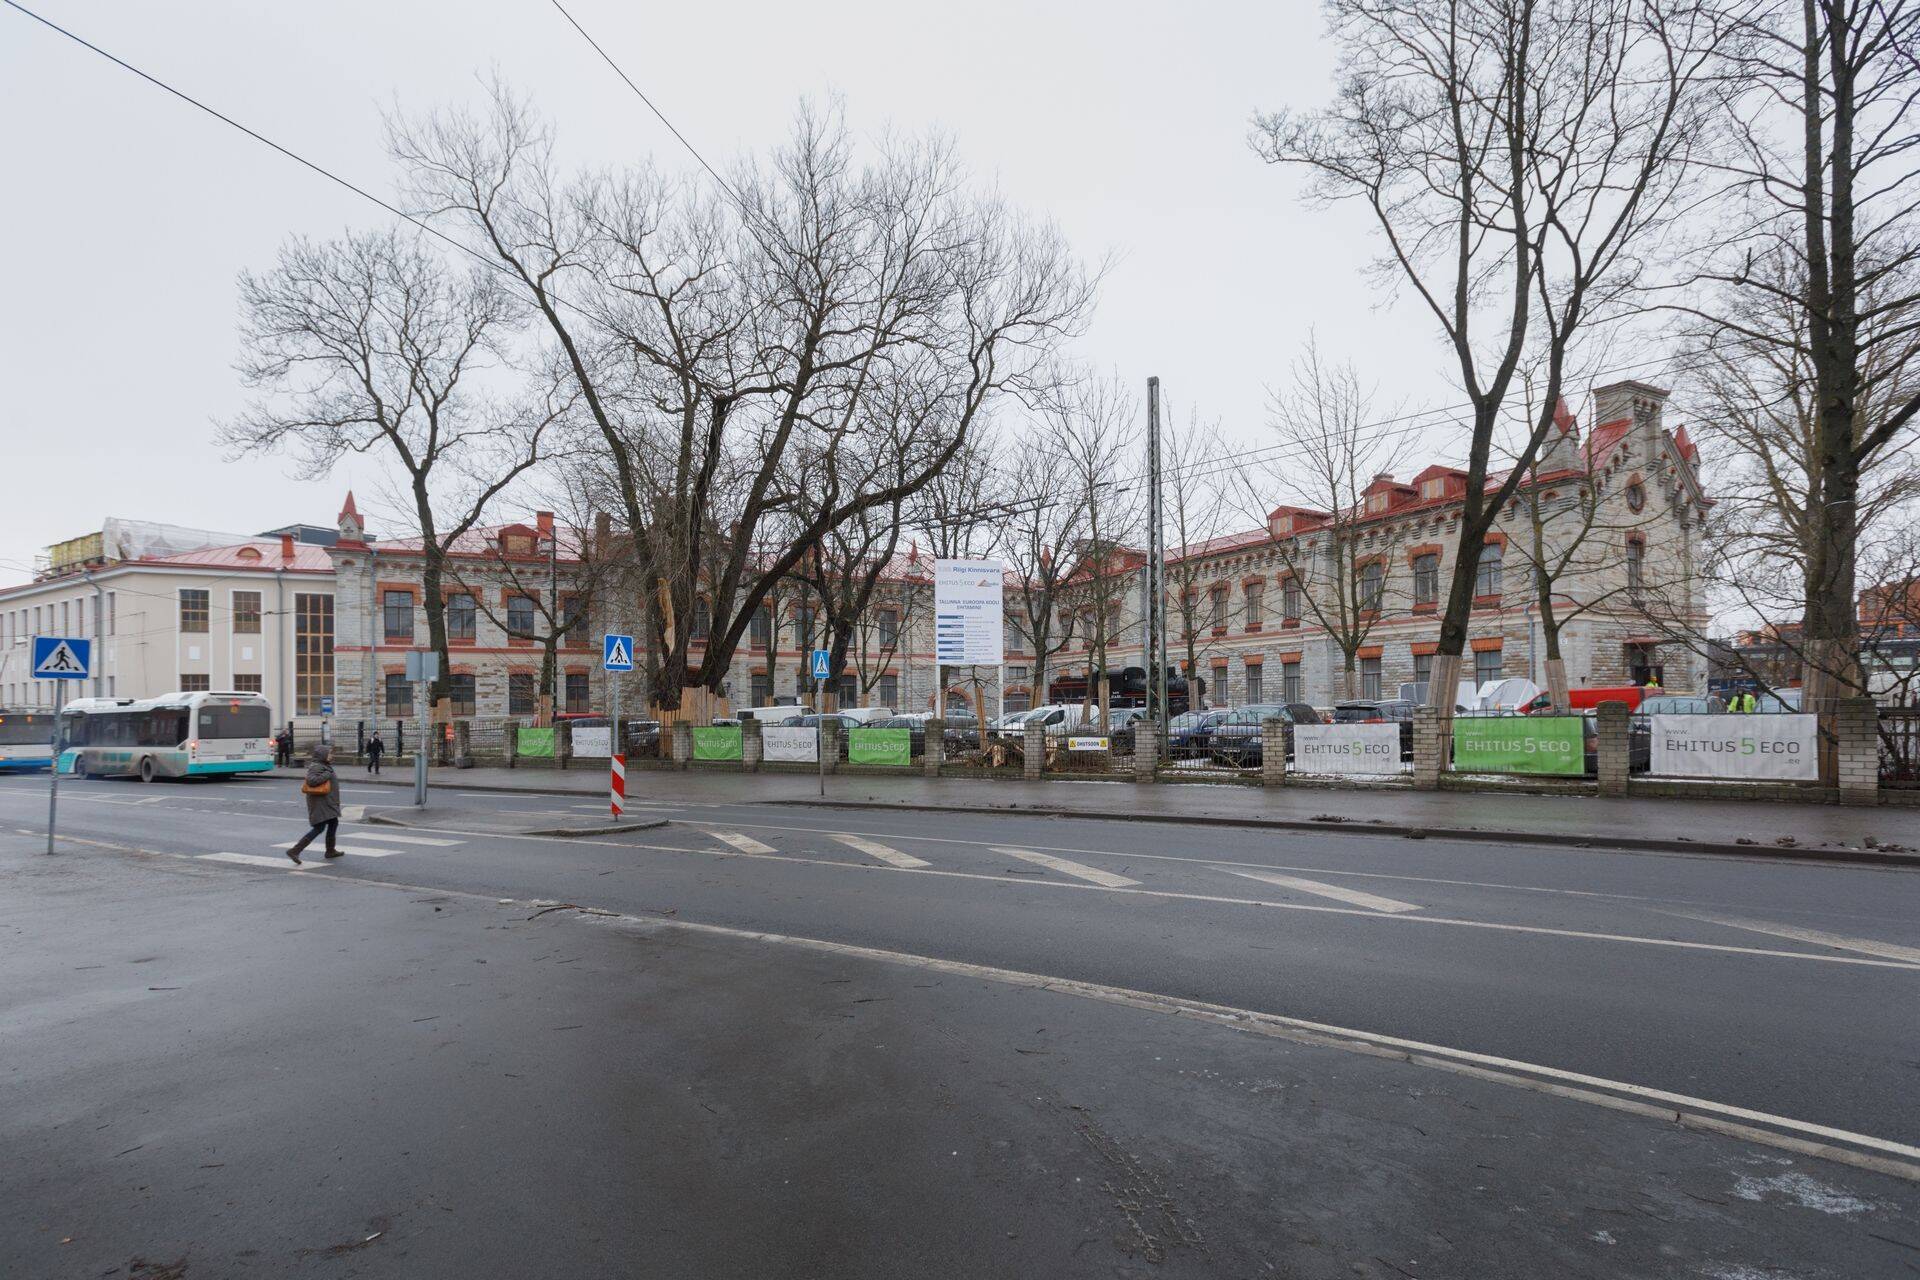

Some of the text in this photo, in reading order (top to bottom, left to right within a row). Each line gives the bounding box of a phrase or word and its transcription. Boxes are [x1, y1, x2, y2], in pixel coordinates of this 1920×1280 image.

[698, 740, 720, 748] EHITUS
[855, 742, 904, 752] EHITUS 5 ECO
[1304, 742, 1390, 756] EHITUS 5 ECO
[1466, 738, 1570, 753] EHITUS 5 ECO
[1666, 738, 1800, 755] EHITUS 5 ECO
